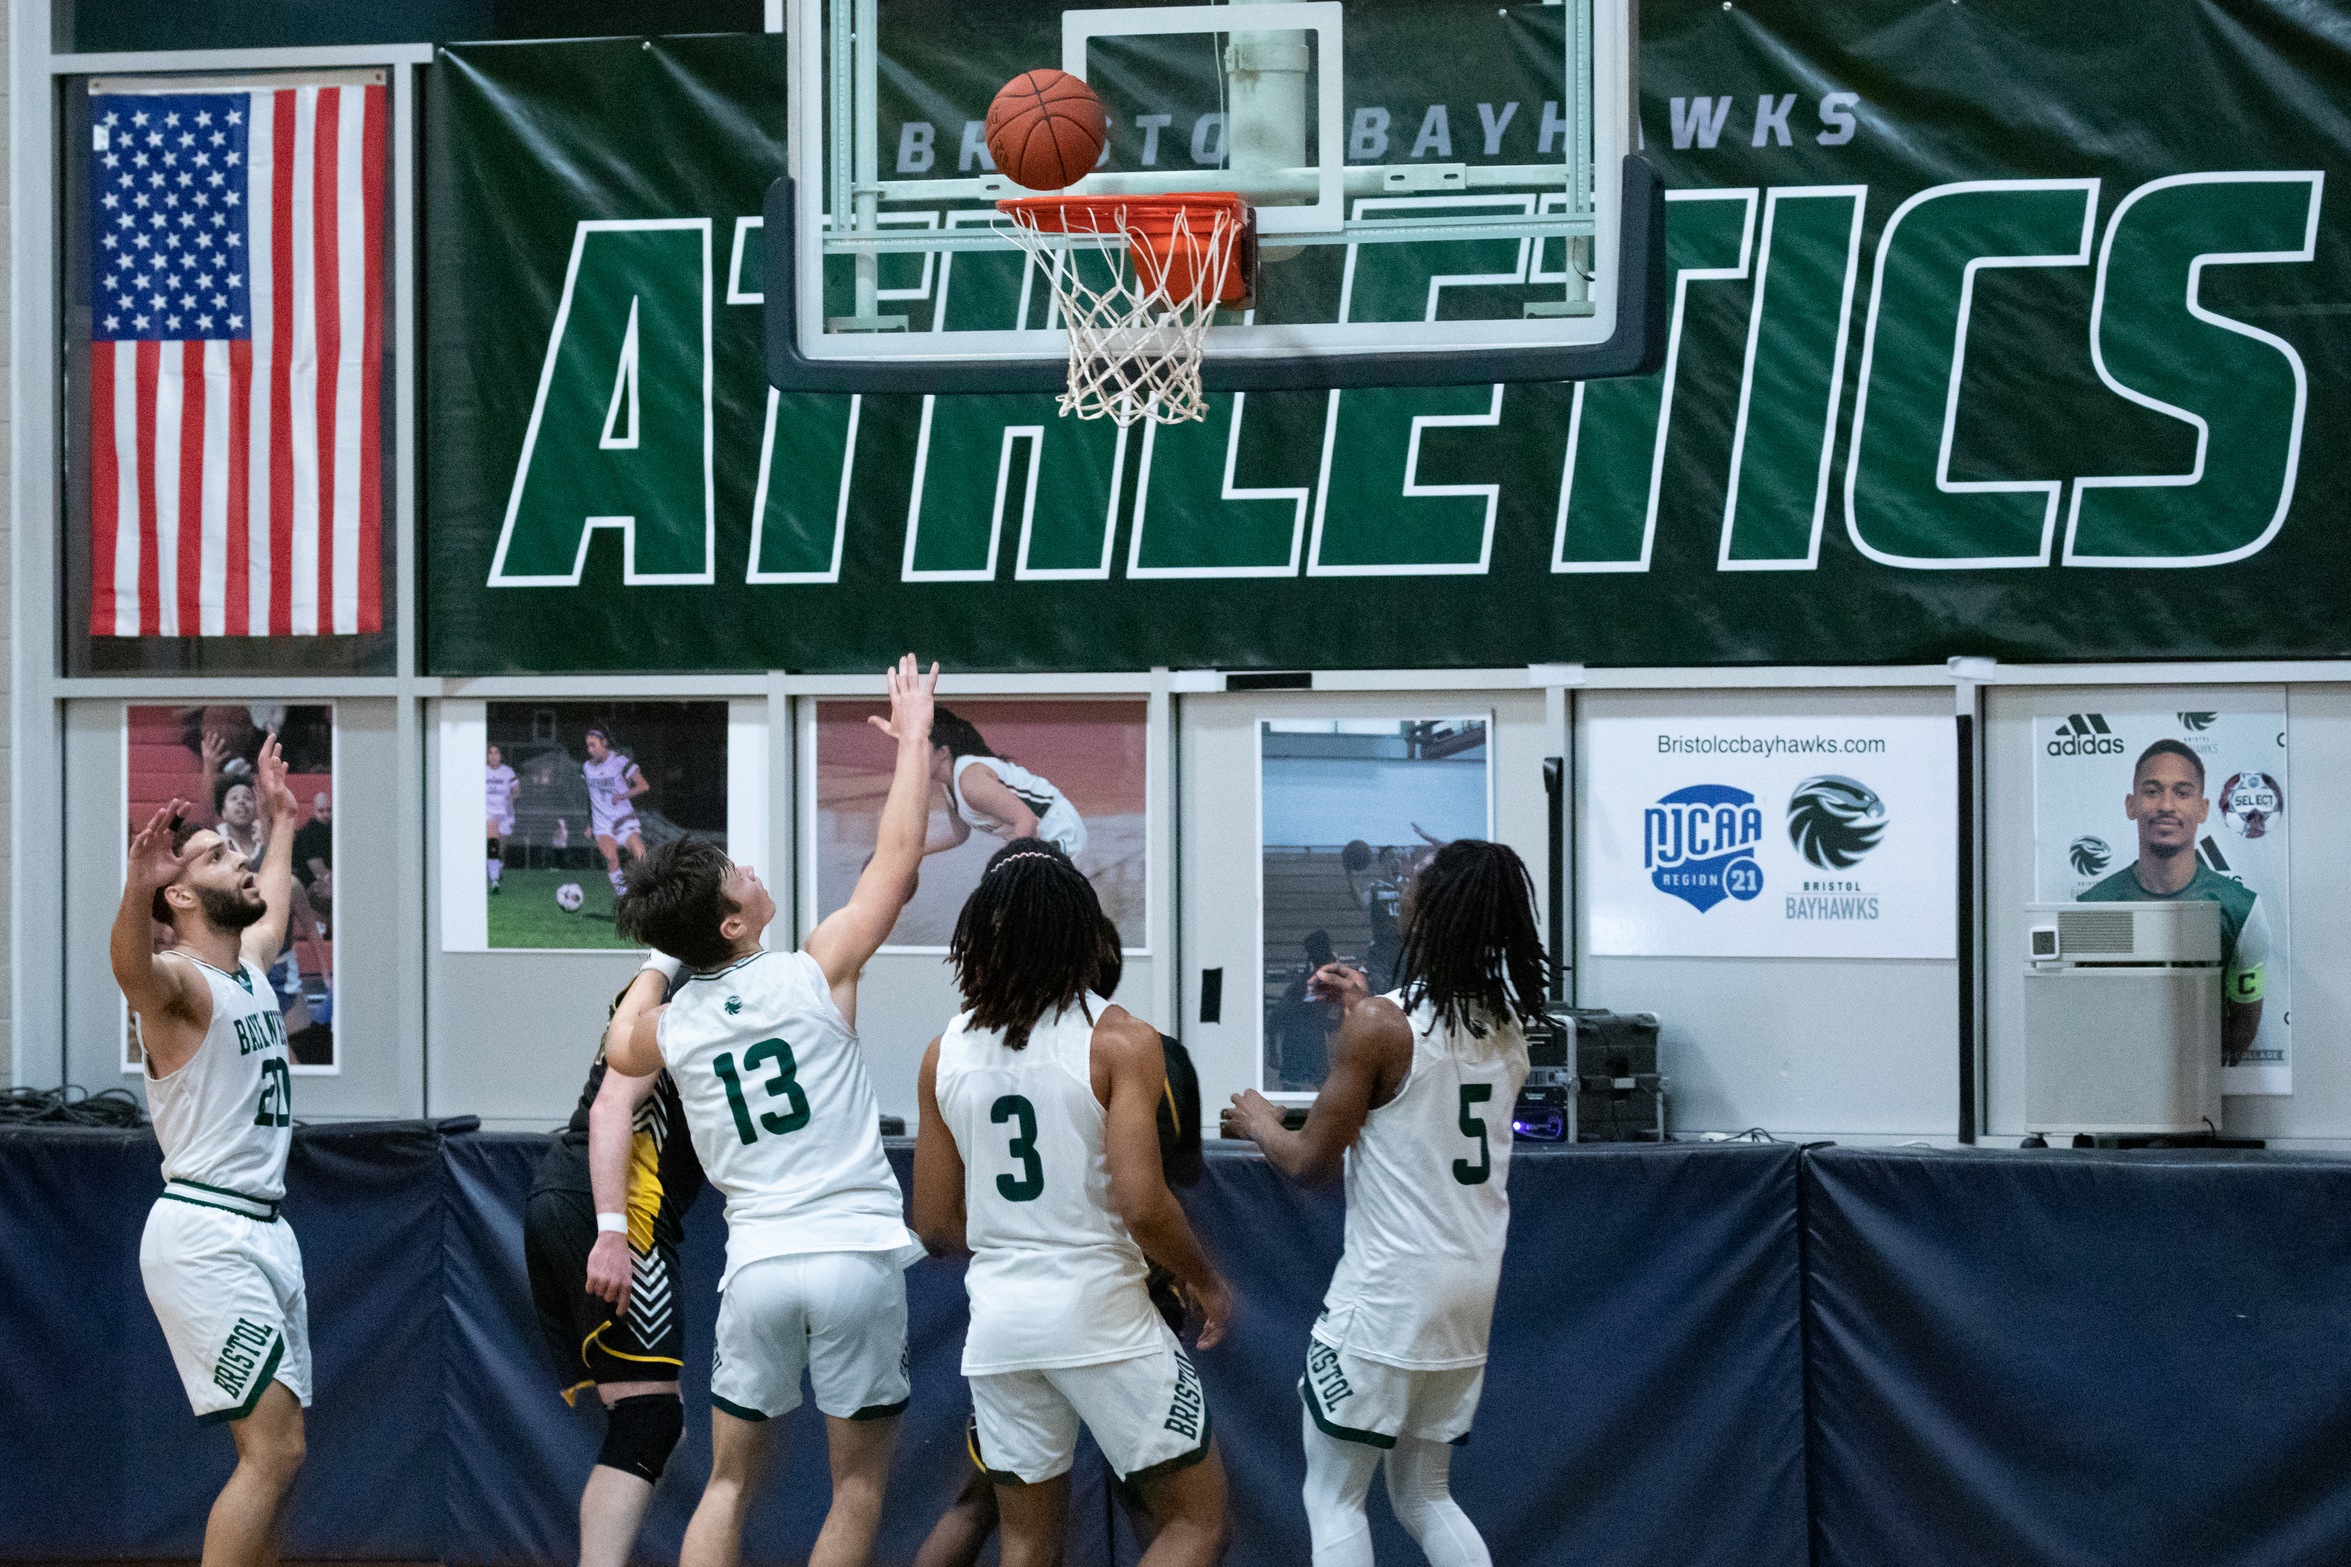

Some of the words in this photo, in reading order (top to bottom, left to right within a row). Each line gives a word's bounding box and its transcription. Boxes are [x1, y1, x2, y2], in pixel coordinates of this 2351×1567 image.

[896, 112, 1230, 173] BRTO
[1348, 92, 1861, 160] BAYHWKS
[486, 170, 2325, 589] ATHLETICS
[1657, 734, 1886, 757] Bristolccbayhawks.com
[2046, 734, 2125, 757] adidas
[2234, 794, 2273, 807] SELECT
[1644, 806, 1763, 870] NJCAA
[1662, 873, 1719, 887] REGION
[1730, 869, 1758, 892] 21
[1785, 897, 1880, 921] BAYHAWKS
[1803, 881, 1862, 892] BRISTOL
[2238, 972, 2256, 995] C
[254, 1056, 291, 1128] 20
[713, 1037, 811, 1146] 13
[990, 1094, 1045, 1203] 3
[1452, 1083, 1493, 1185] 5
[213, 1317, 274, 1401] BRISTOL
[1310, 1340, 1354, 1414] ISTOL
